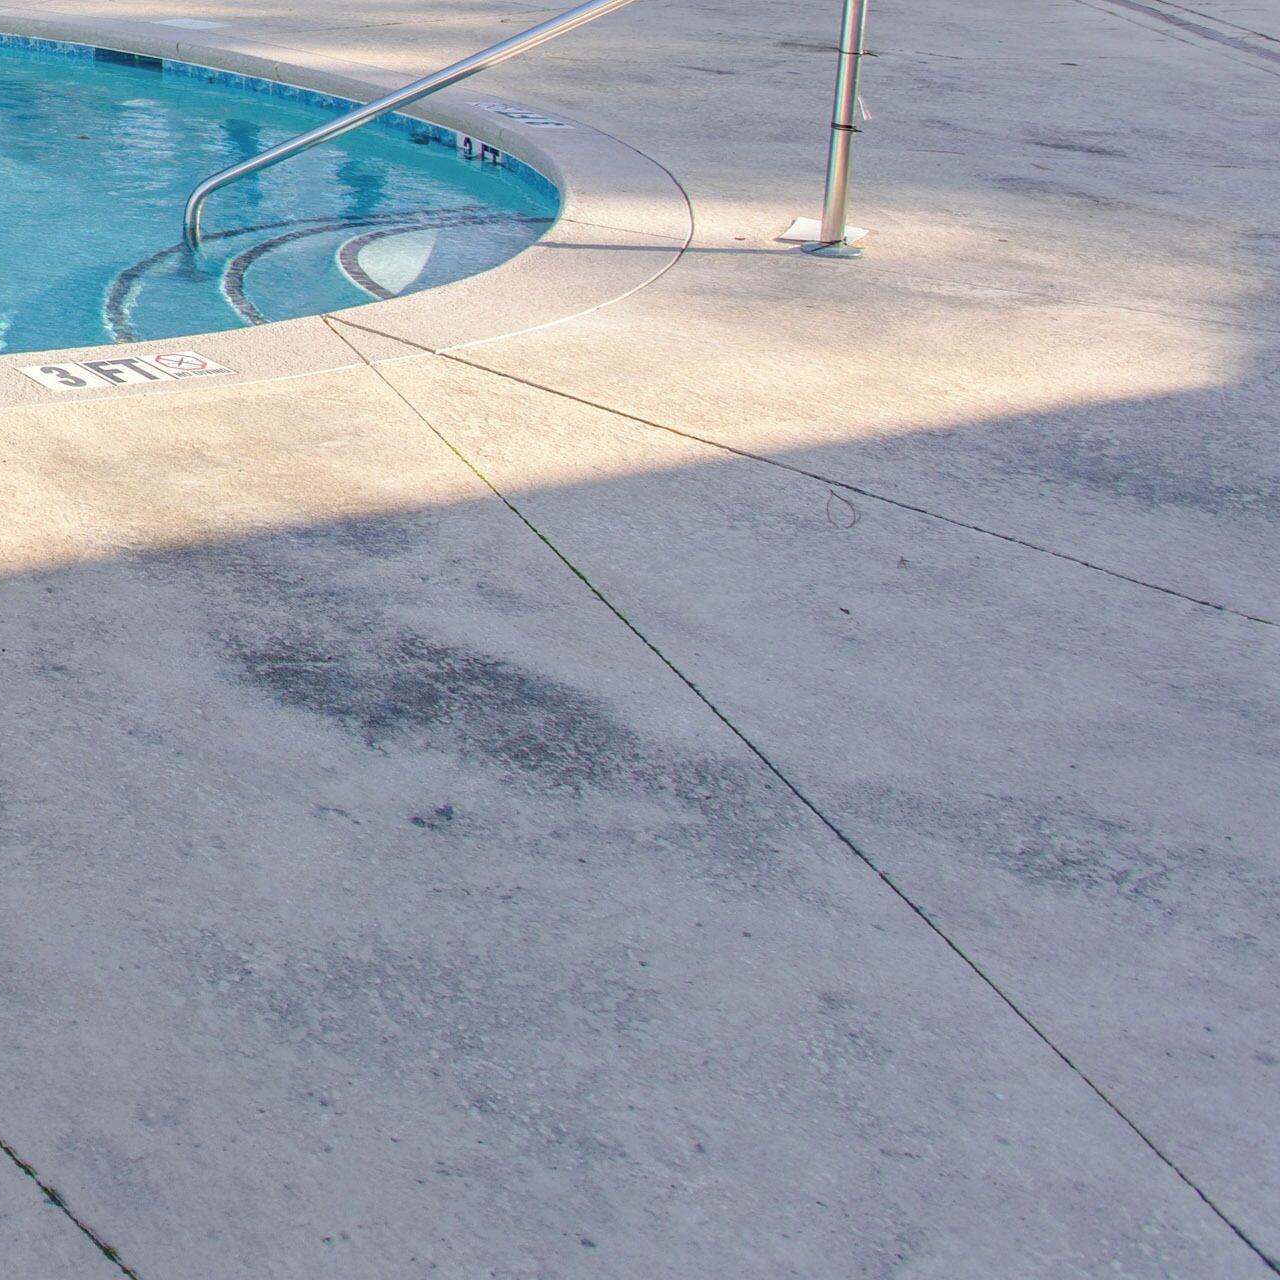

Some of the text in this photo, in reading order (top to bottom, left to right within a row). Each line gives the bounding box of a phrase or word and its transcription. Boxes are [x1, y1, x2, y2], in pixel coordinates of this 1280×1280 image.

[481, 143, 500, 166] FT
[40, 358, 160, 387] 3 FT
[193, 368, 231, 376] DIVING
